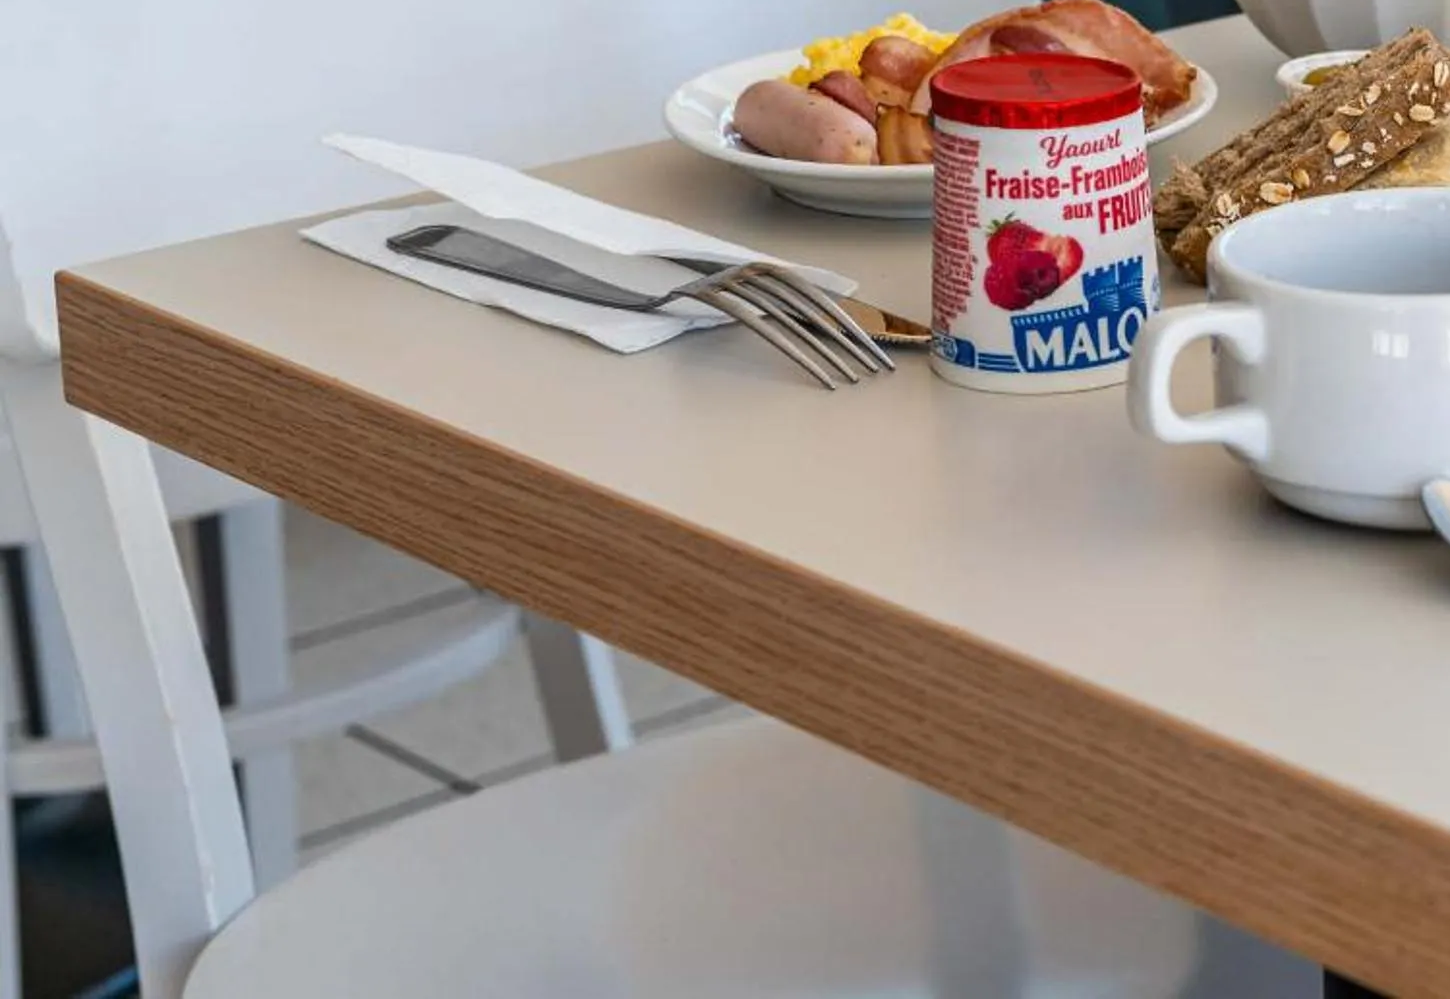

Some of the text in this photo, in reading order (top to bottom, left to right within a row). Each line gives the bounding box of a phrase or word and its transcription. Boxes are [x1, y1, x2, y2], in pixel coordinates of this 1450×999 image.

[1039, 128, 1122, 168] Yaourt
[986, 148, 1147, 198] Fraise-Frambois
[1063, 202, 1094, 221] aux
[1025, 306, 1145, 369] MALO
